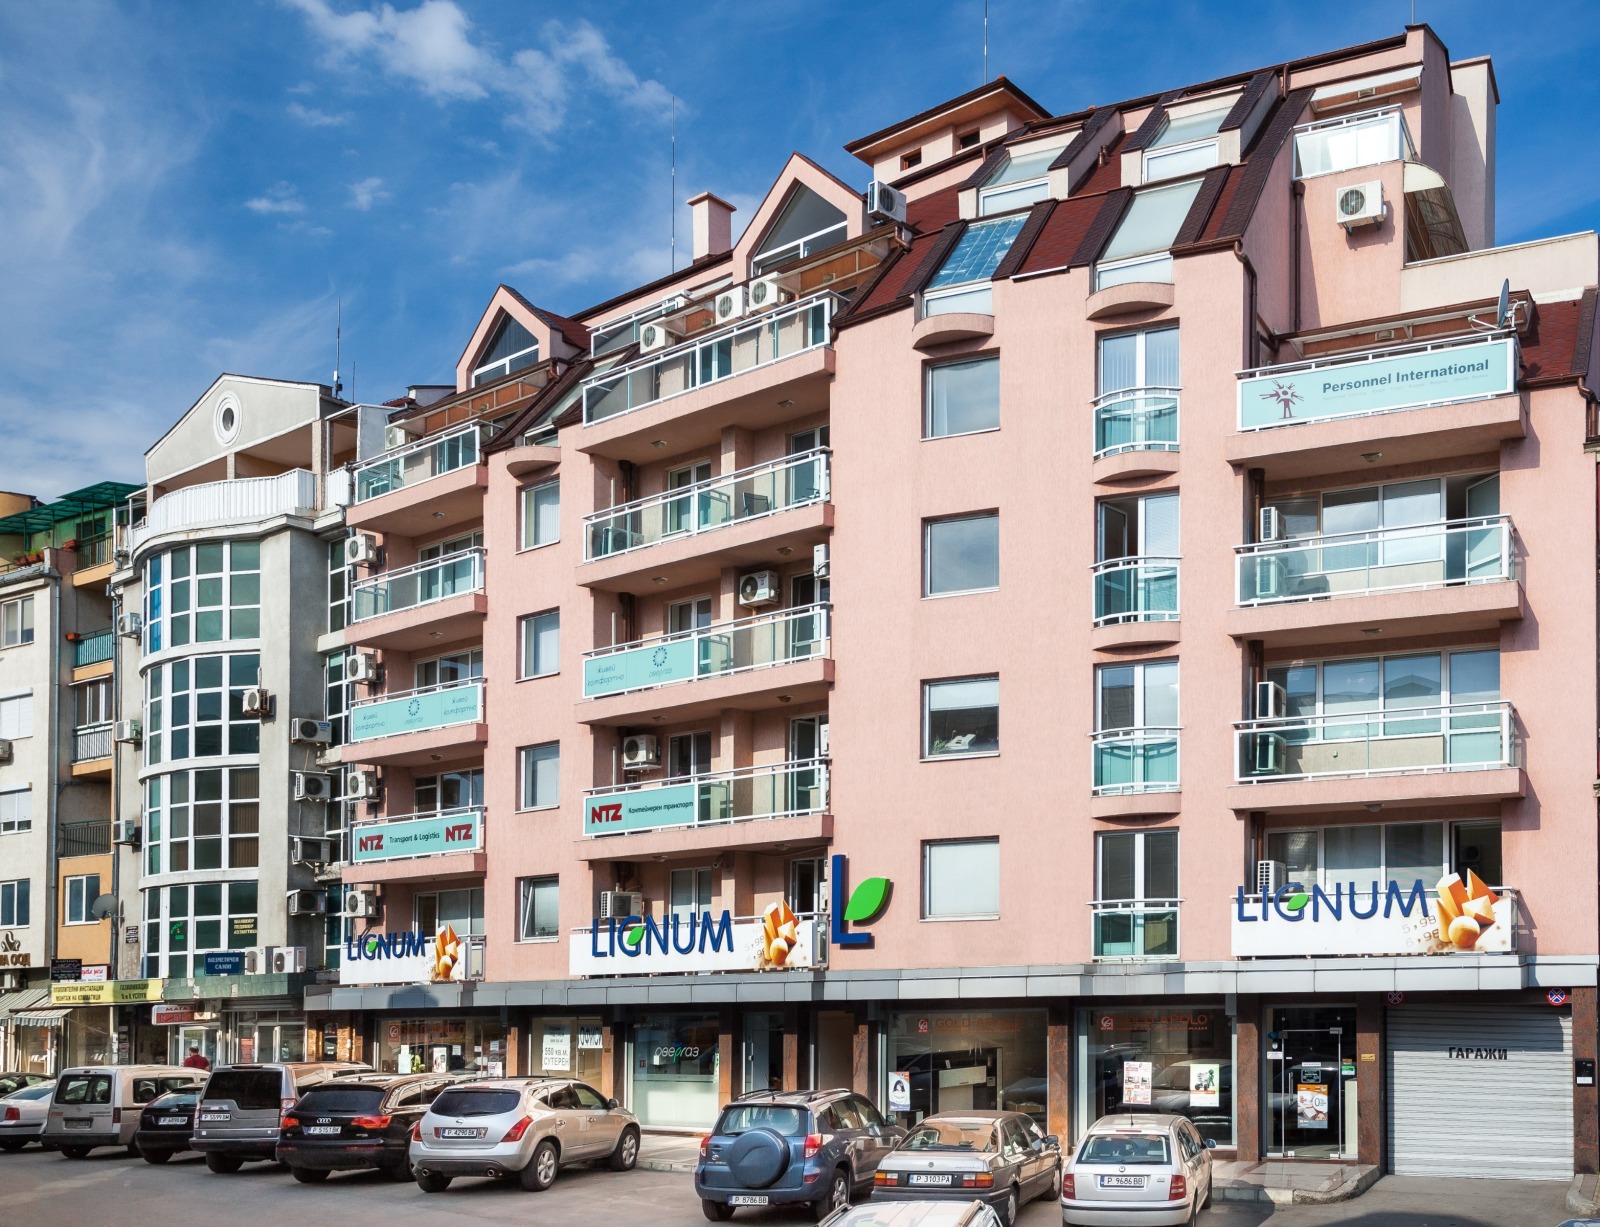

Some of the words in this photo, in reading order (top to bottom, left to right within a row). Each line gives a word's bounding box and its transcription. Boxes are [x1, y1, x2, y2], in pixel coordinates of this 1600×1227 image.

[1322, 373, 1392, 394] Personnel
[1396, 359, 1489, 383] International
[591, 803, 623, 824] NTZ
[628, 805, 663, 815] Контейнерен
[663, 801, 694, 812] транспорт
[359, 834, 384, 852] NTZ
[389, 836, 413, 844] Transport
[419, 831, 440, 841] Logistics
[445, 823, 473, 842] NTZ
[1237, 879, 1429, 922] LIGNUM
[591, 909, 734, 958] LIGNUM
[1402, 915, 1437, 934] 5,98
[346, 930, 426, 961] LIGNUM
[543, 1057, 569, 1067] СУТЕРЕН
[1448, 1046, 1508, 1060] ГАРАЖИ
